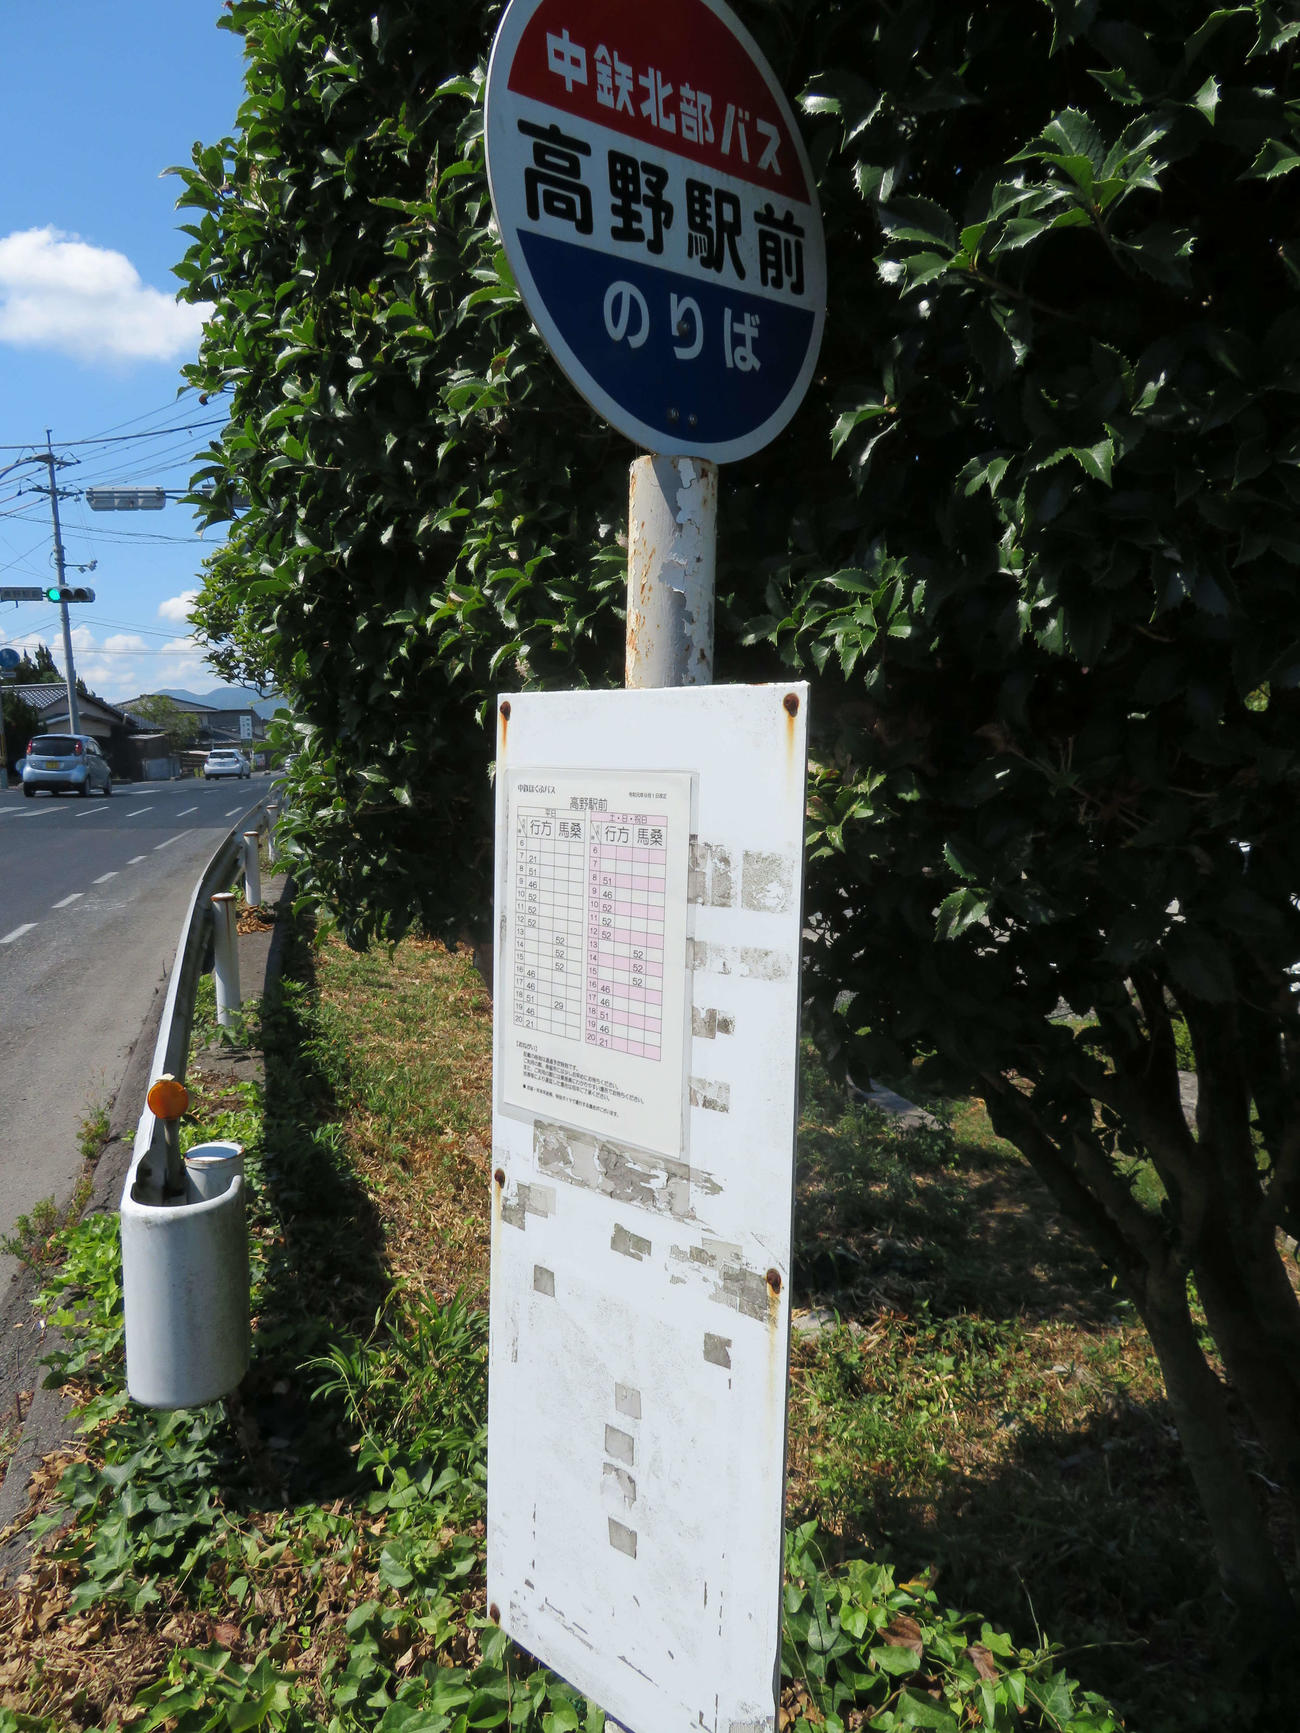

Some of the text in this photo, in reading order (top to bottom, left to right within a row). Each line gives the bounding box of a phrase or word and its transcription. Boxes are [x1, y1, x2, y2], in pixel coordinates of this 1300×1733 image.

[546, 28, 783, 176] 中鉄北部バス
[517, 118, 805, 296] 高野駅前
[603, 280, 761, 373] のりば
[569, 796, 608, 811] 高野駅前
[530, 820, 552, 836] 行方
[558, 821, 582, 839] 馬桑
[605, 825, 630, 843] 行方
[637, 828, 663, 846] 馬桑
[528, 856, 537, 864] 21
[528, 868, 537, 876] 51
[528, 881, 538, 889] 46
[603, 877, 612, 885] 51
[517, 890, 525, 898] 10
[592, 887, 613, 899] 9 46
[527, 906, 537, 914] 52
[602, 904, 612, 912] 52
[527, 919, 537, 927] 52
[602, 918, 612, 926] 52
[602, 932, 612, 940] 52
[555, 937, 565, 945] 52
[555, 950, 565, 958] 52
[633, 950, 643, 959] 52
[633, 964, 643, 973] 52
[526, 970, 536, 978] 46
[589, 967, 643, 986] 15 52
[526, 983, 536, 991] 46
[600, 985, 611, 993] 46
[526, 995, 535, 1003] 51
[554, 1001, 564, 1009] 29
[600, 999, 610, 1007] 46
[588, 1007, 609, 1020] 18 51
[525, 1020, 534, 1028] 21
[588, 1020, 610, 1033] 19 46
[600, 1039, 609, 1047] 21
